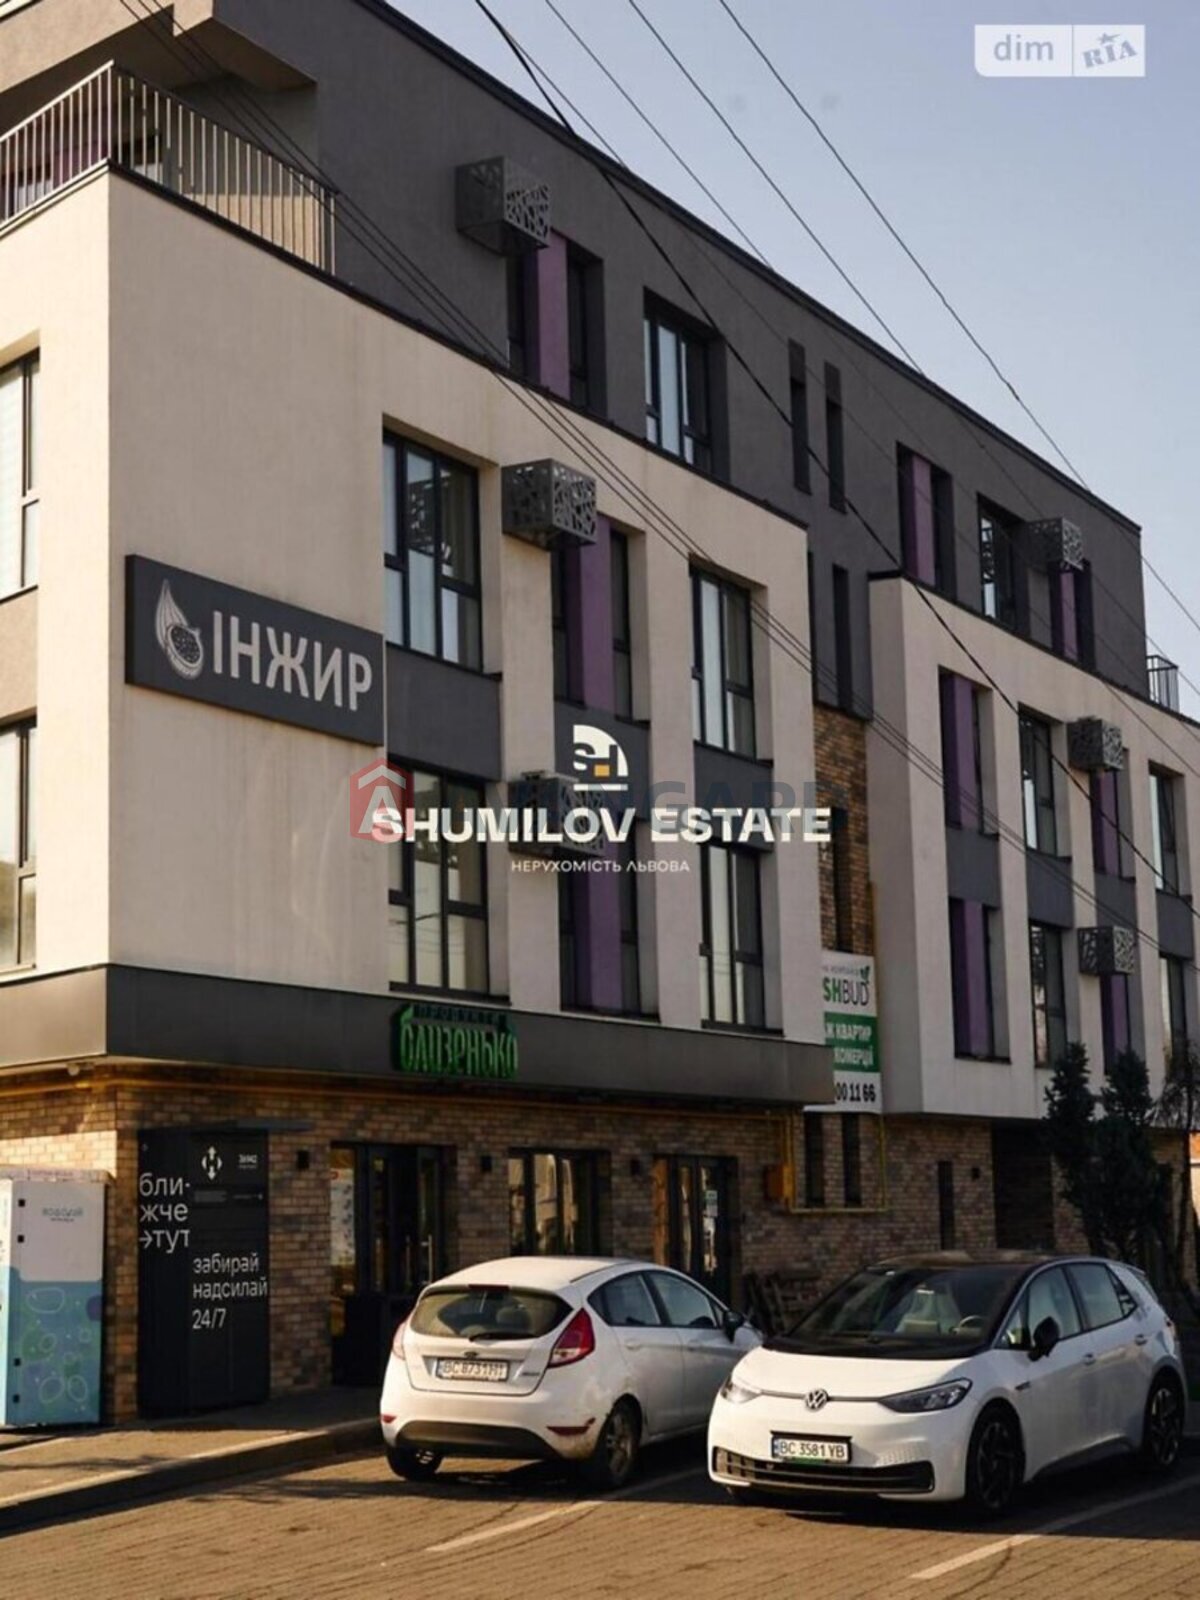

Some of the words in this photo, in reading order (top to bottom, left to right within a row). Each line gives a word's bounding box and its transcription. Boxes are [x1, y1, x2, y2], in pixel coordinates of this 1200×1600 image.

[213, 610, 373, 711] ІНЖИР
[139, 1203, 189, 1222] жче
[193, 1252, 260, 1276] забирай
[193, 1276, 268, 1300] надсилай
[192, 1307, 228, 1330] 24/7
